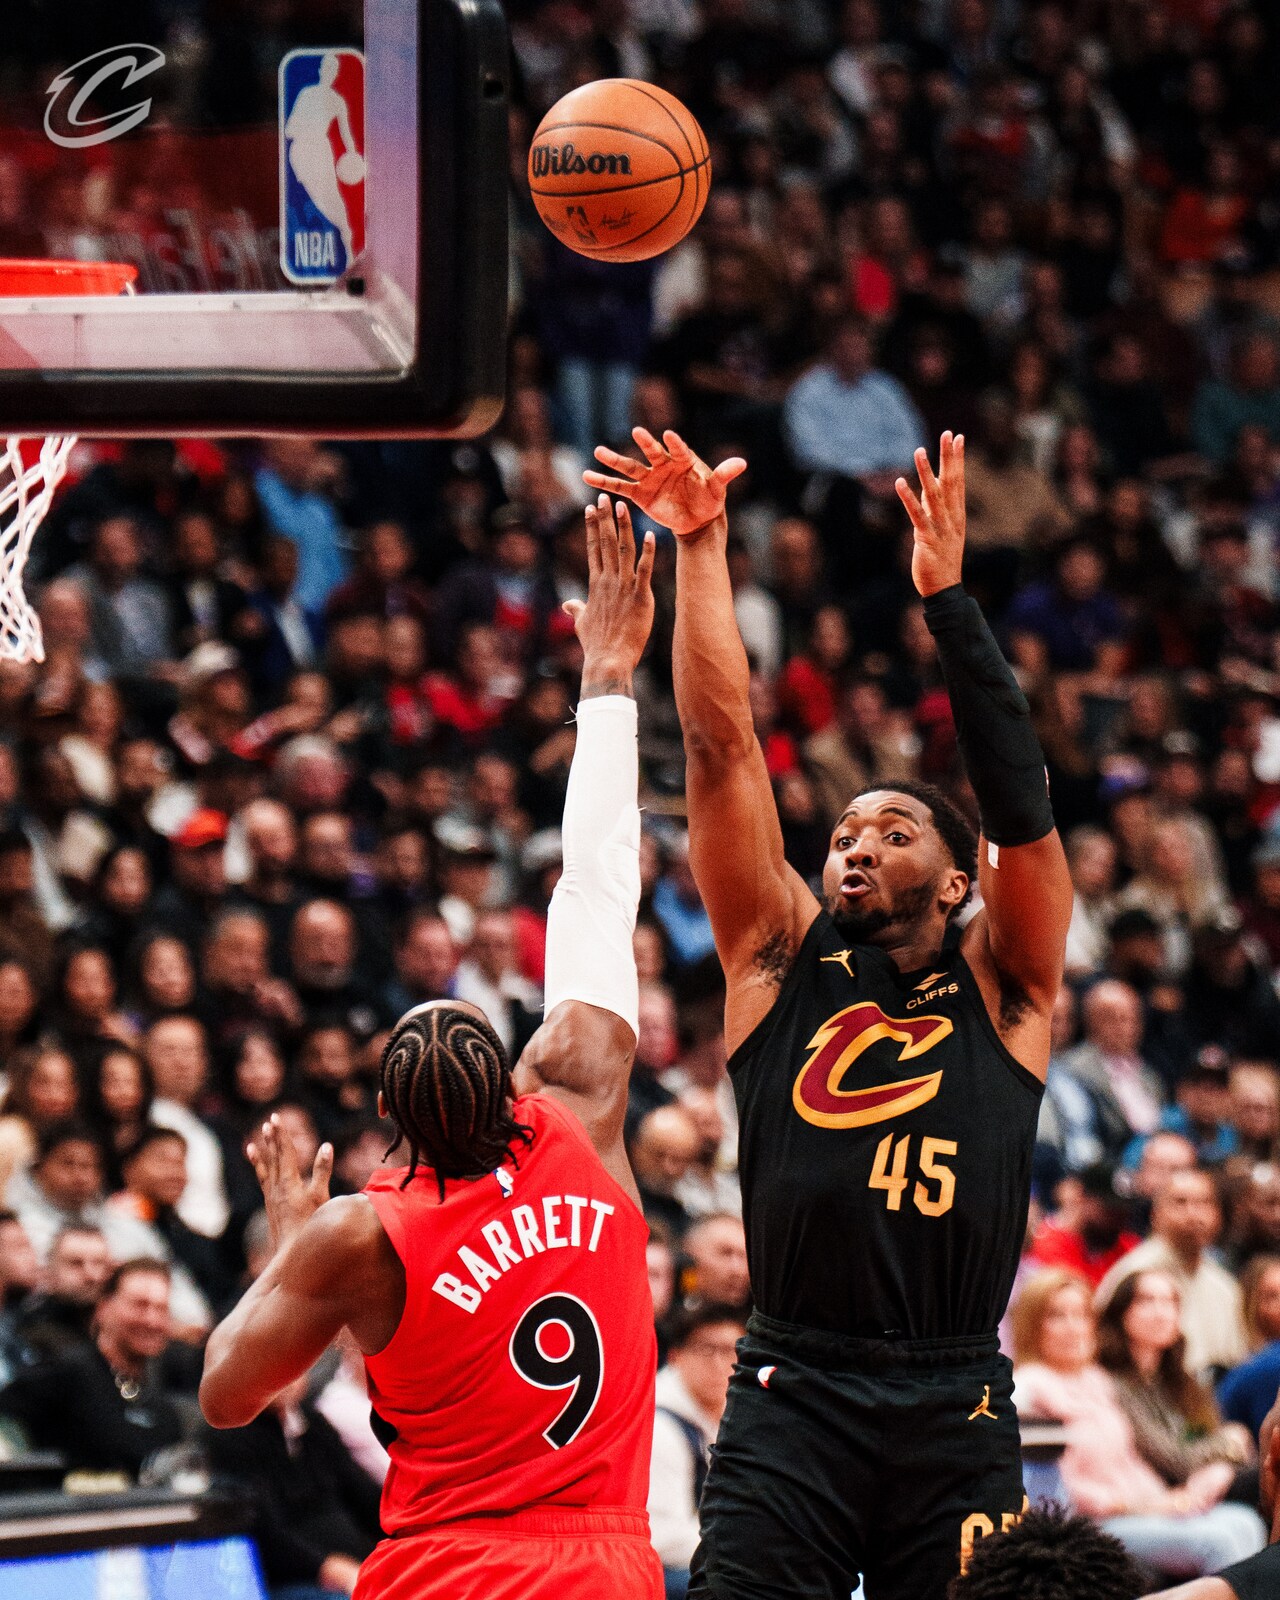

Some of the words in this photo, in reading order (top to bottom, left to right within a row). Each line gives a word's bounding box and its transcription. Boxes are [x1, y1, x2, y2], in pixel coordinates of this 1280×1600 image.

[531, 143, 632, 178] Wilson
[294, 231, 335, 268] NBA
[906, 982, 960, 1010] CLIFFS
[792, 1001, 954, 1130] C
[868, 1132, 958, 1217] 45
[431, 1194, 615, 1315] BARRETT
[508, 1291, 605, 1451] 9
